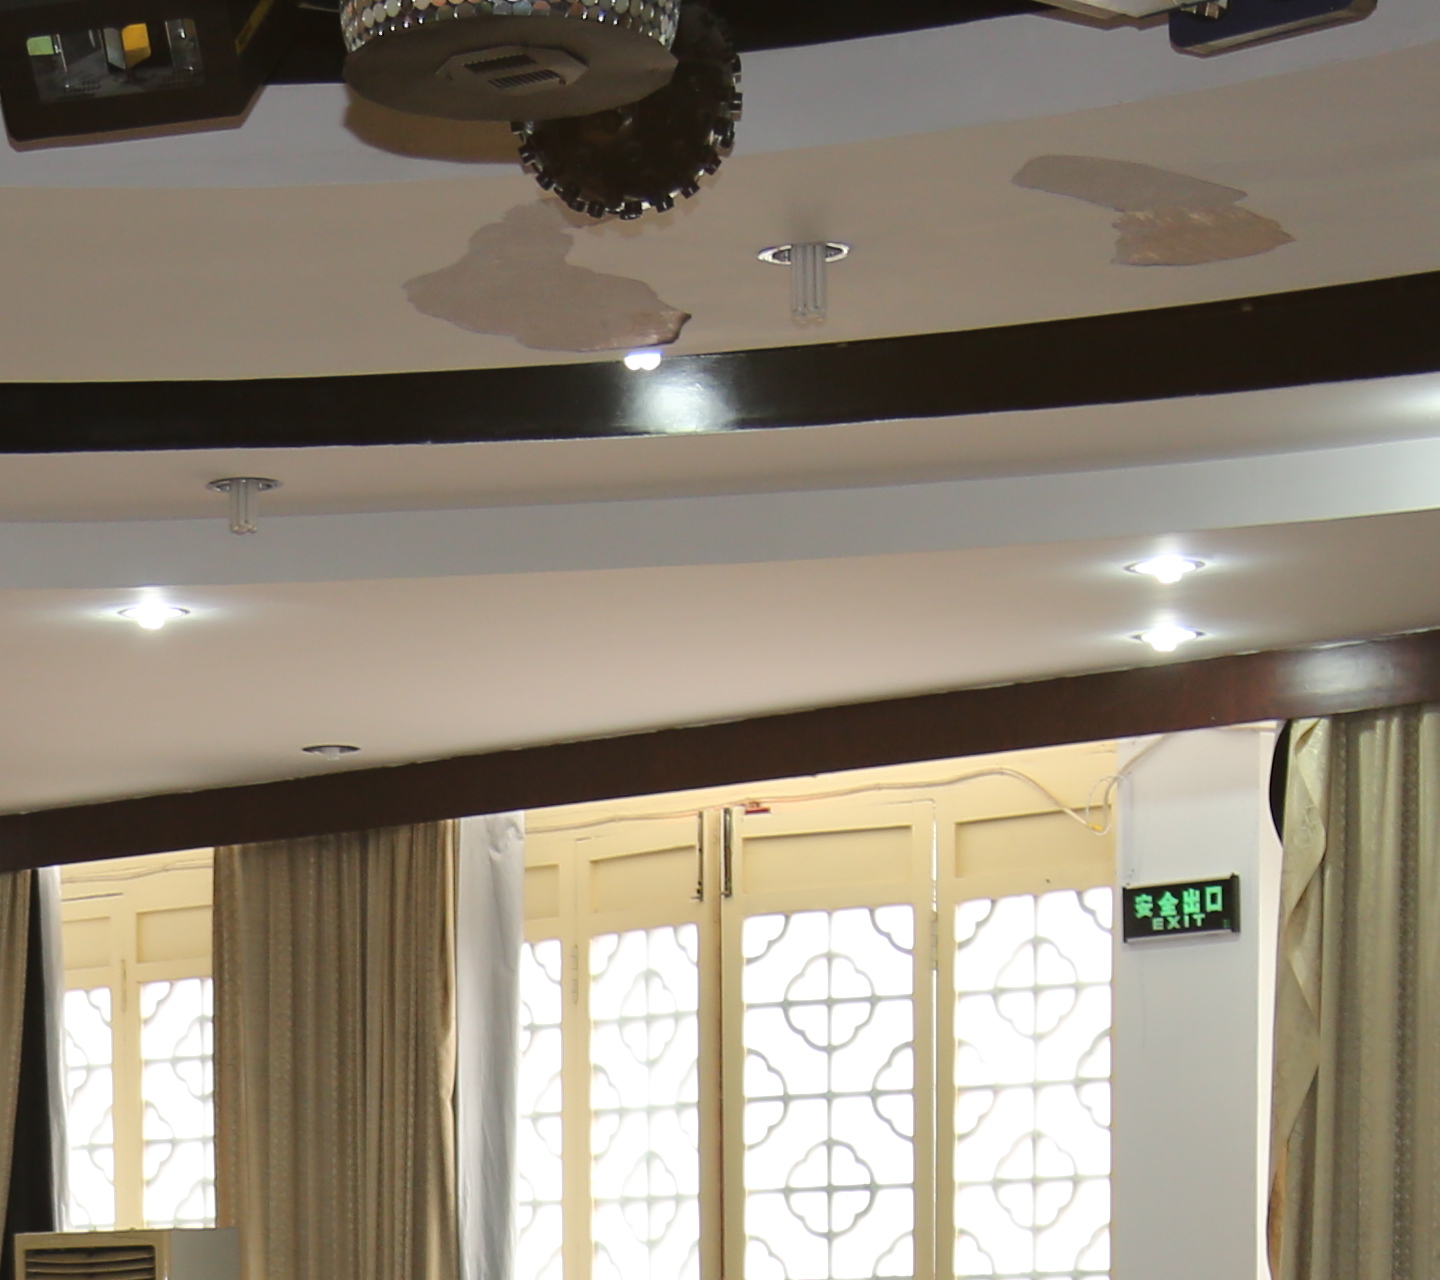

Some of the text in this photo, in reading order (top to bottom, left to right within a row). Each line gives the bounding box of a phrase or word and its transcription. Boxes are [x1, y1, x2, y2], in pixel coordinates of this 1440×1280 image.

[1135, 885, 1223, 919] 安全出口
[1152, 913, 1205, 930] EXIT
